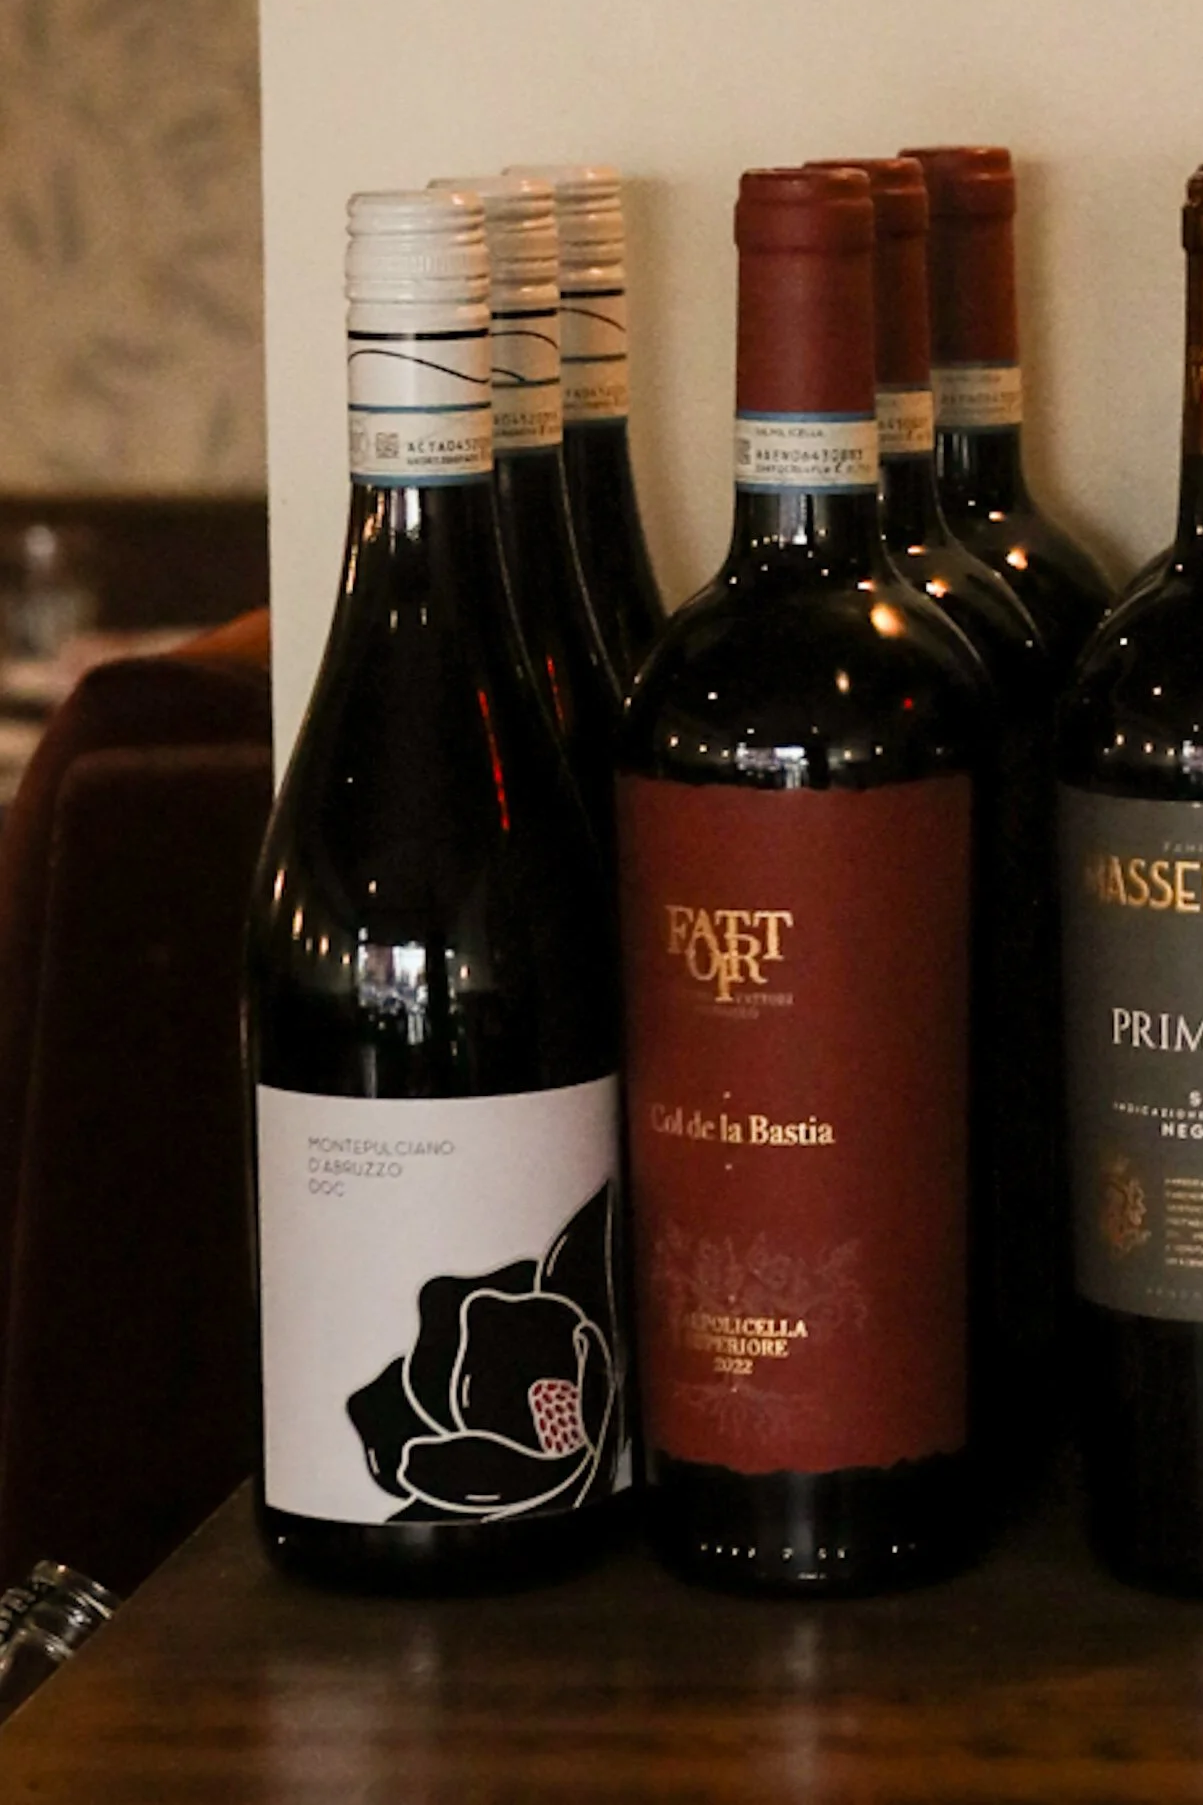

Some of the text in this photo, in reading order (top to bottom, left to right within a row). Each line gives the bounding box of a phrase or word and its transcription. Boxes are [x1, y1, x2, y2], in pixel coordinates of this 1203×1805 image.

[686, 1110, 716, 1141] de
[719, 1112, 744, 1144] la
[748, 1113, 837, 1146] Bastia
